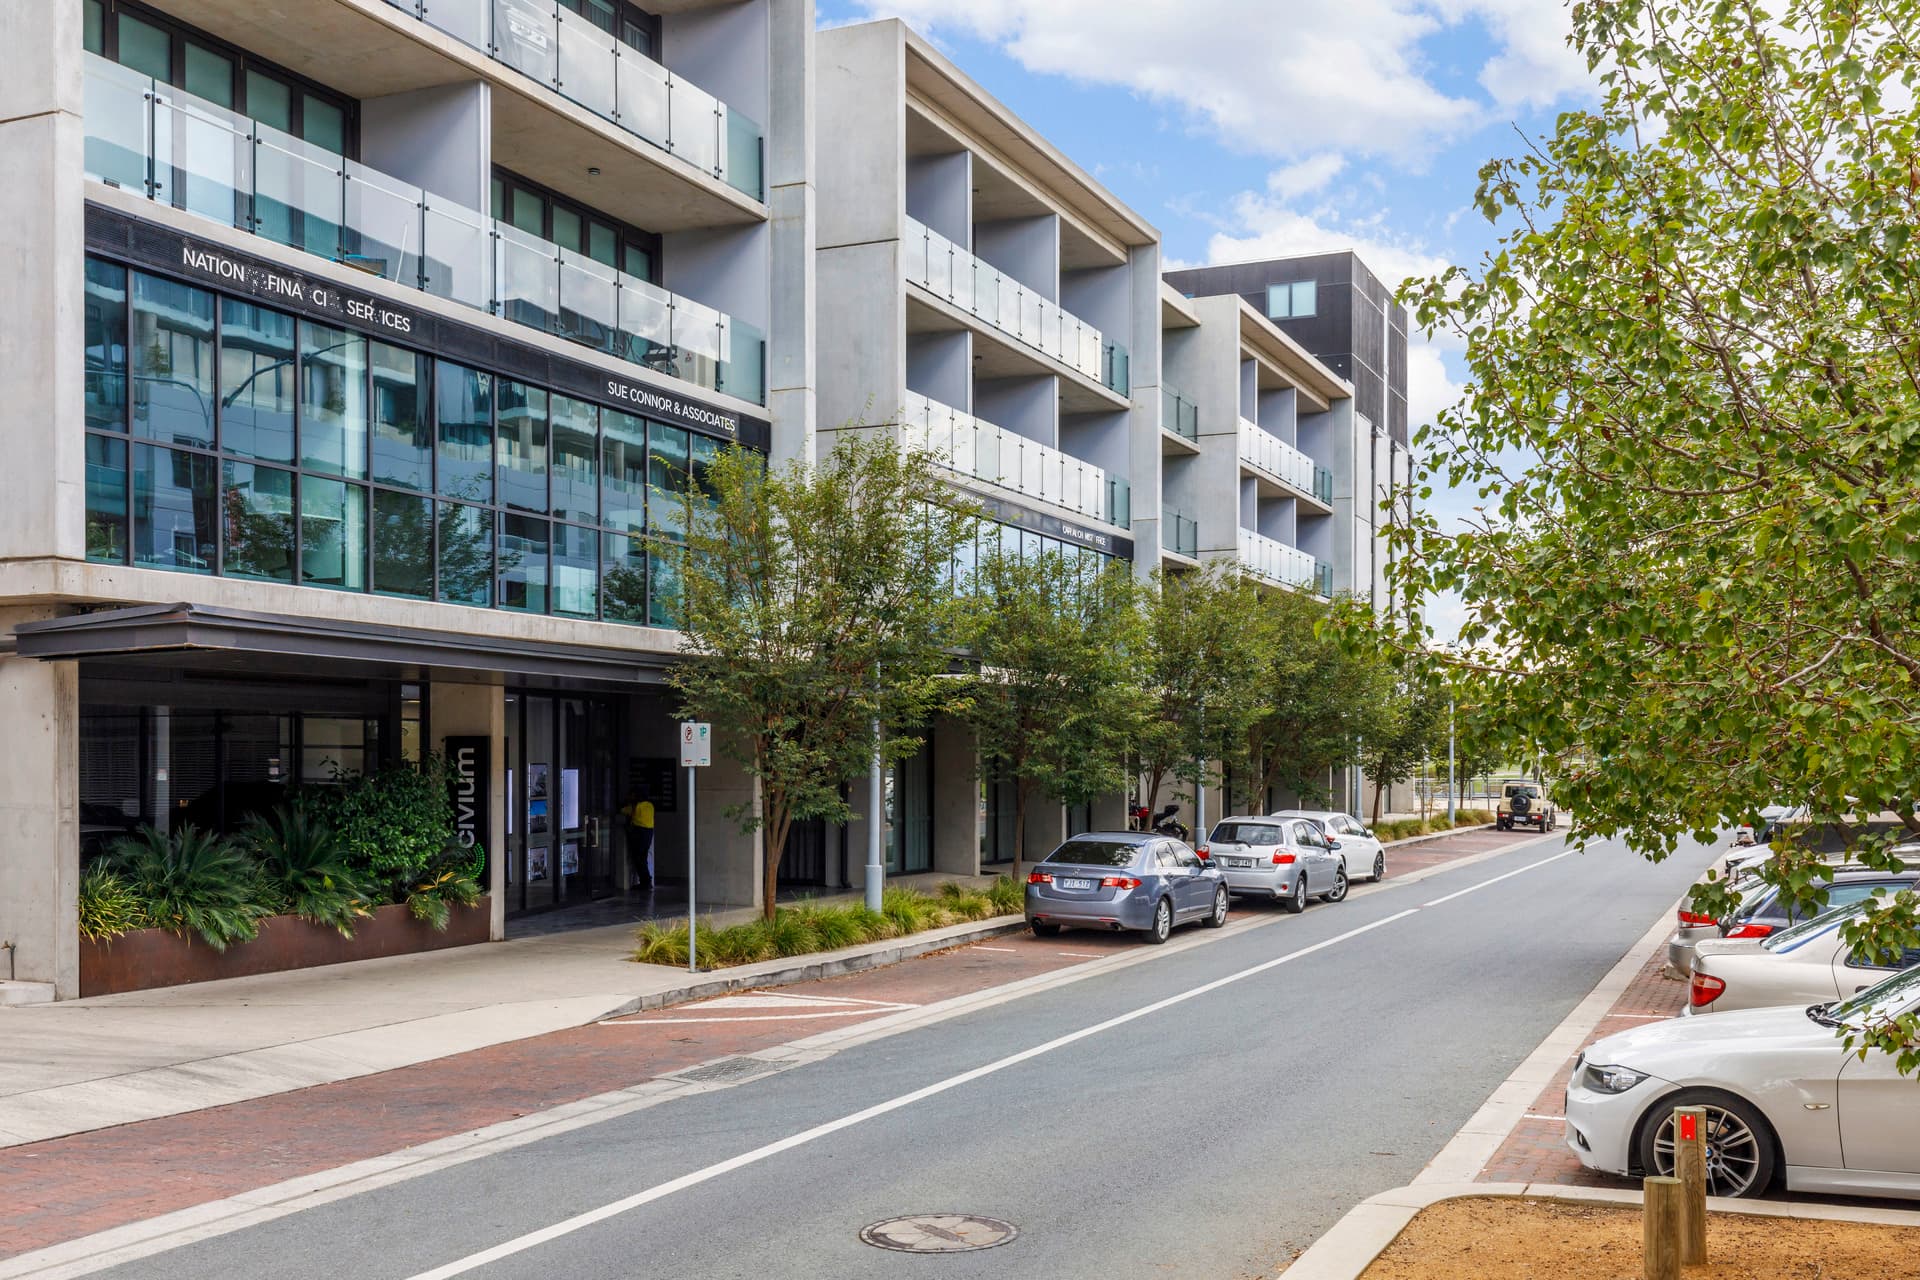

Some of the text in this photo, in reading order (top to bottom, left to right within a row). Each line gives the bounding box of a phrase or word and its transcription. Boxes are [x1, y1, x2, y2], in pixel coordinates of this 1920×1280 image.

[183, 246, 411, 333] NATION FINACI SERICES
[608, 381, 736, 432] SUE CONNOR & ASSOCIATES
[457, 747, 475, 849] civium
